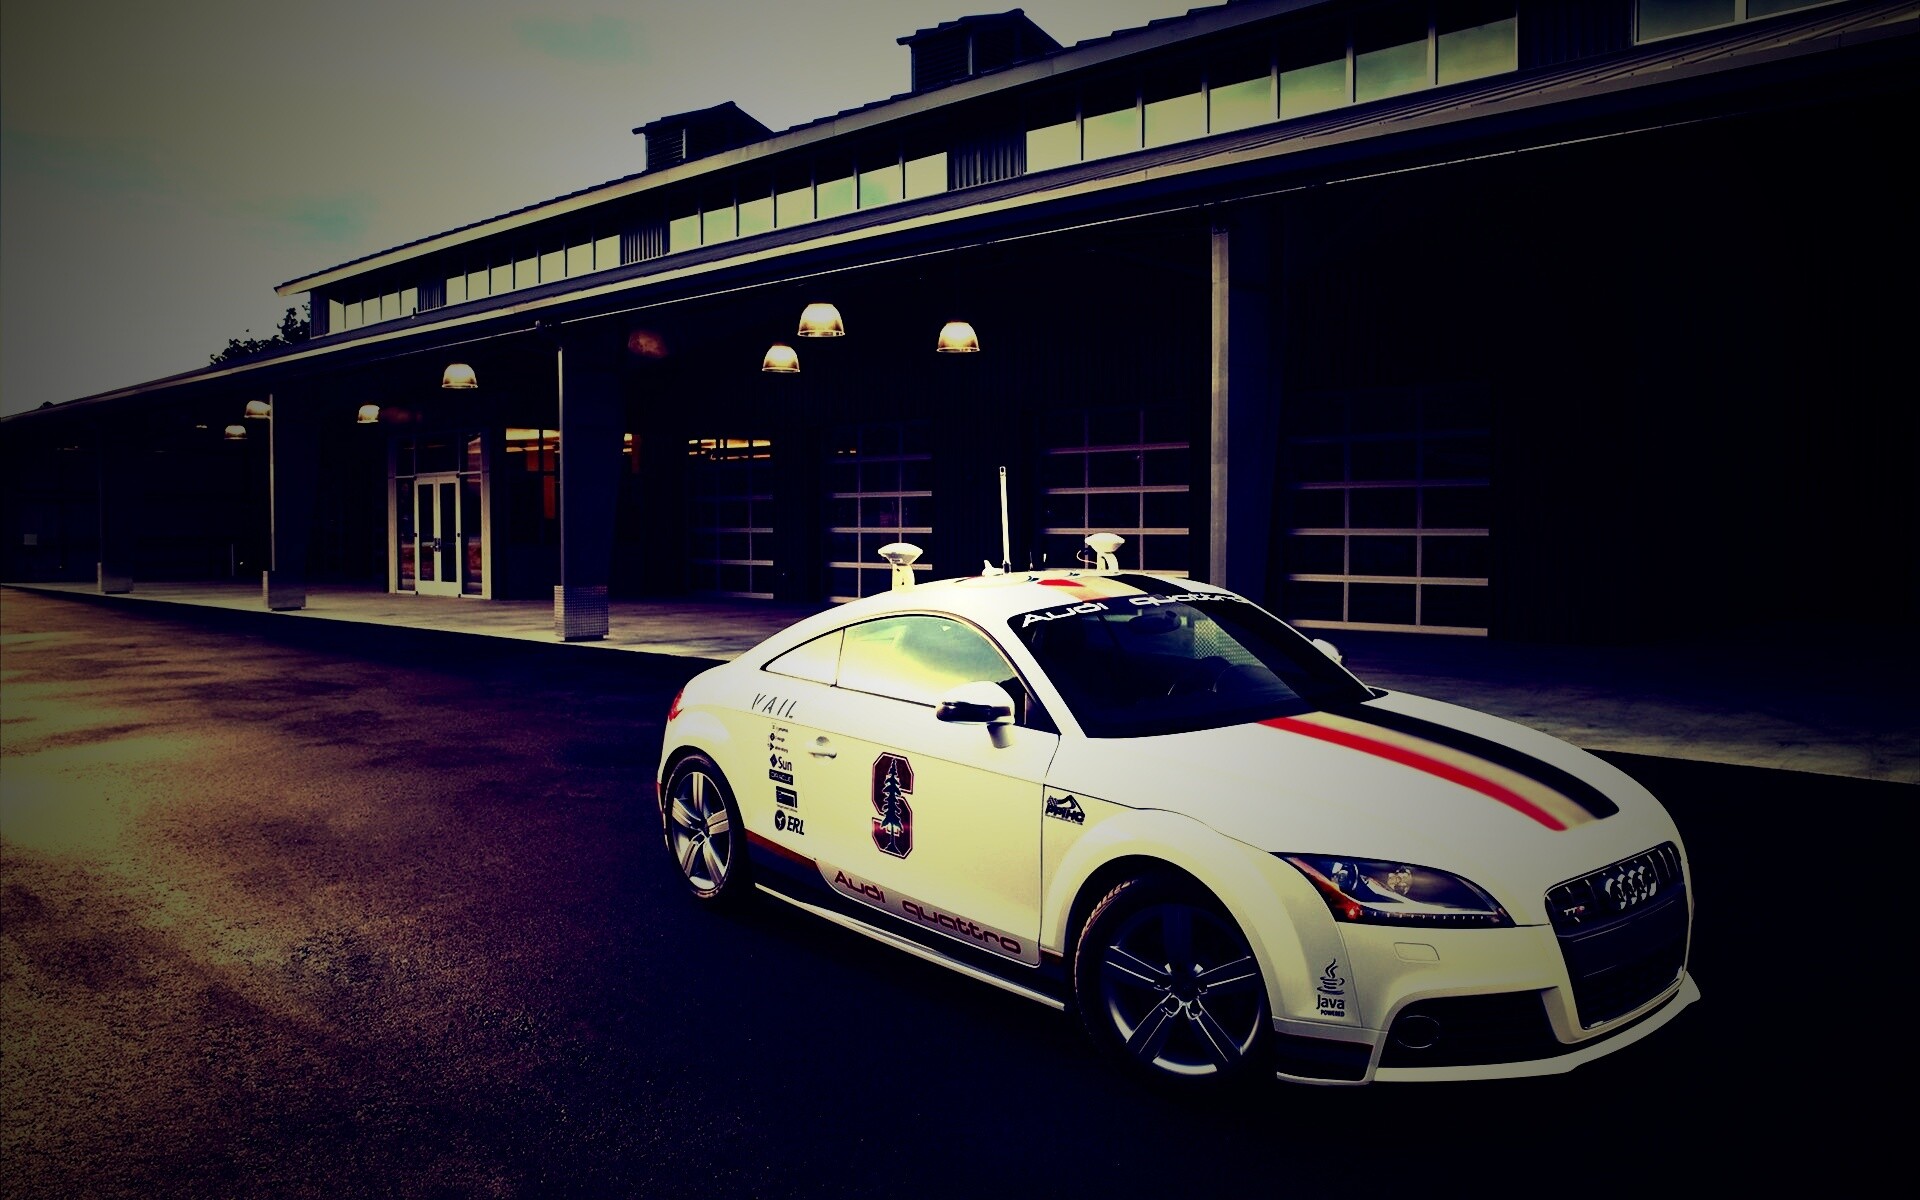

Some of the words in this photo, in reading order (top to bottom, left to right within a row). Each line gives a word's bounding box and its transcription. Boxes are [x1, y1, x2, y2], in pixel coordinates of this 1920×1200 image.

[1022, 602, 1109, 628] Audi
[751, 693, 797, 718] VAIL
[777, 756, 793, 771] Sun
[786, 815, 805, 836] ERL
[834, 871, 885, 904] Audi
[902, 900, 1022, 955] quattro
[1316, 994, 1345, 1010] Java
